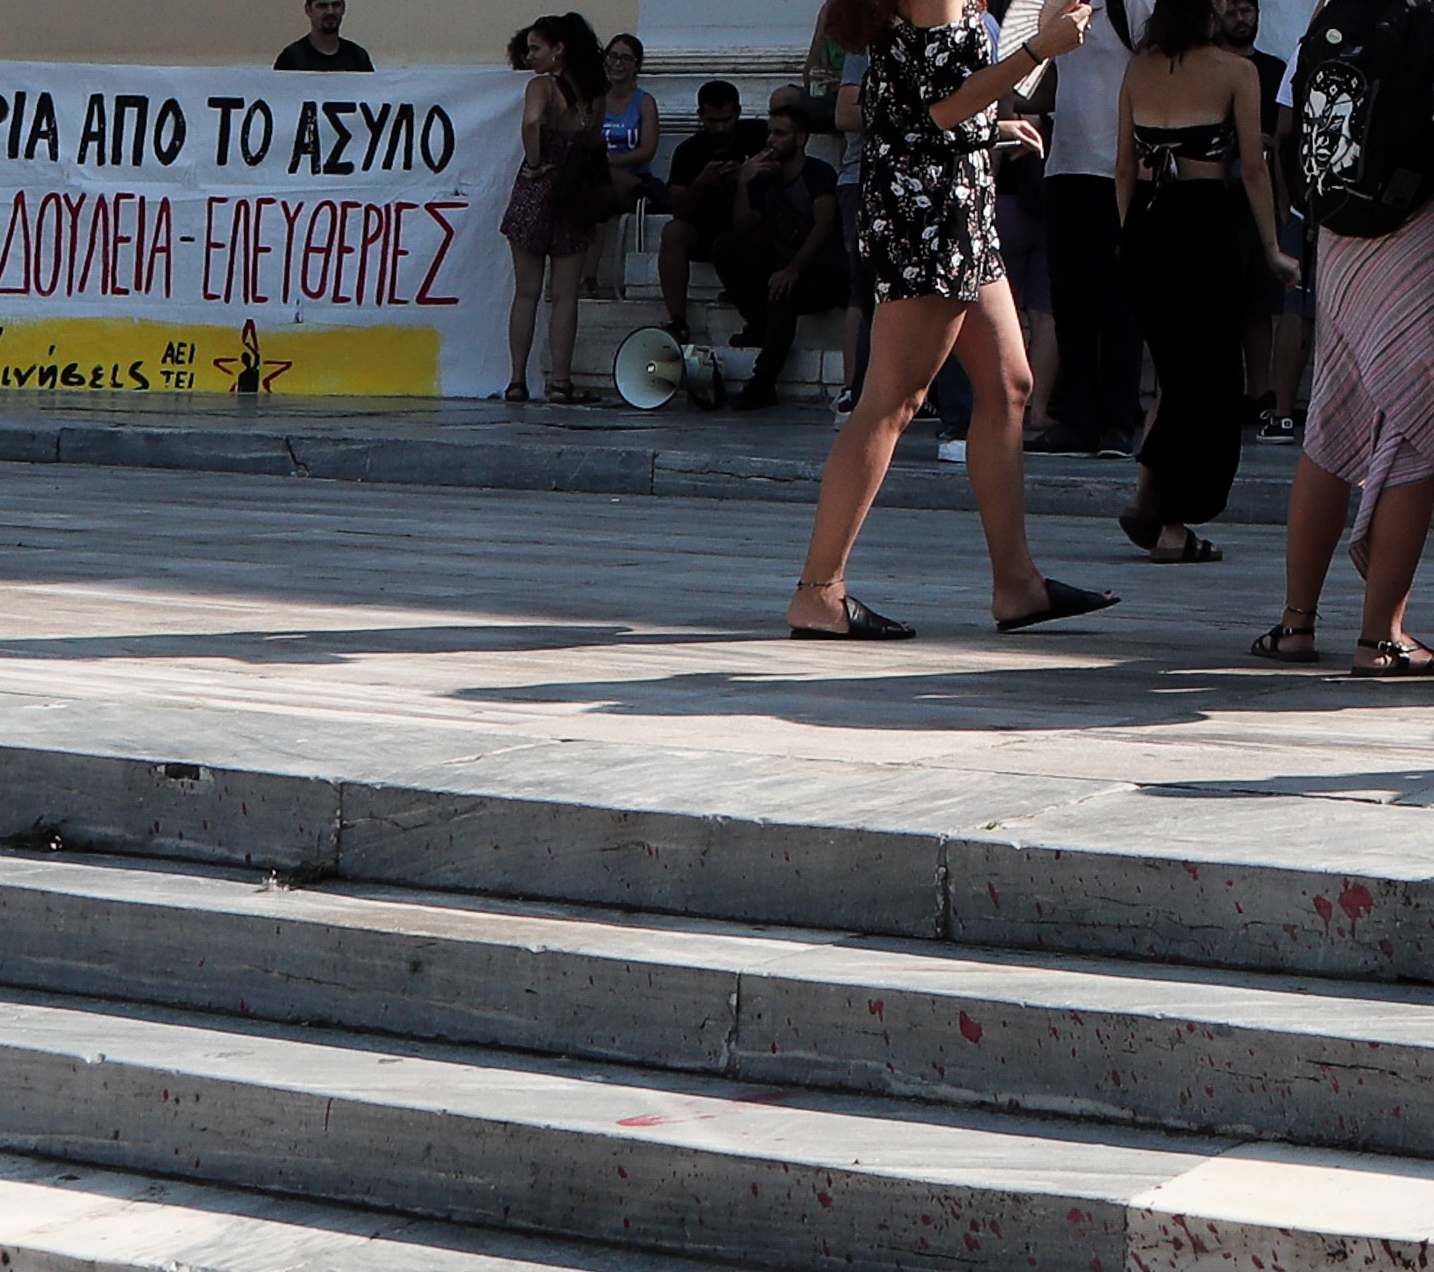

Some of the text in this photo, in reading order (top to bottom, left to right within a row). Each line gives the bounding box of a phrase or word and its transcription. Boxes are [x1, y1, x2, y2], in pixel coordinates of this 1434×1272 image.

[76, 92, 187, 167] ΑΠΟ
[207, 96, 274, 167] ΤΟ
[287, 100, 456, 175] ΑΣΥΛΟ
[160, 340, 196, 365] ΑΕΙ
[159, 370, 195, 390] ΤΕΙ
